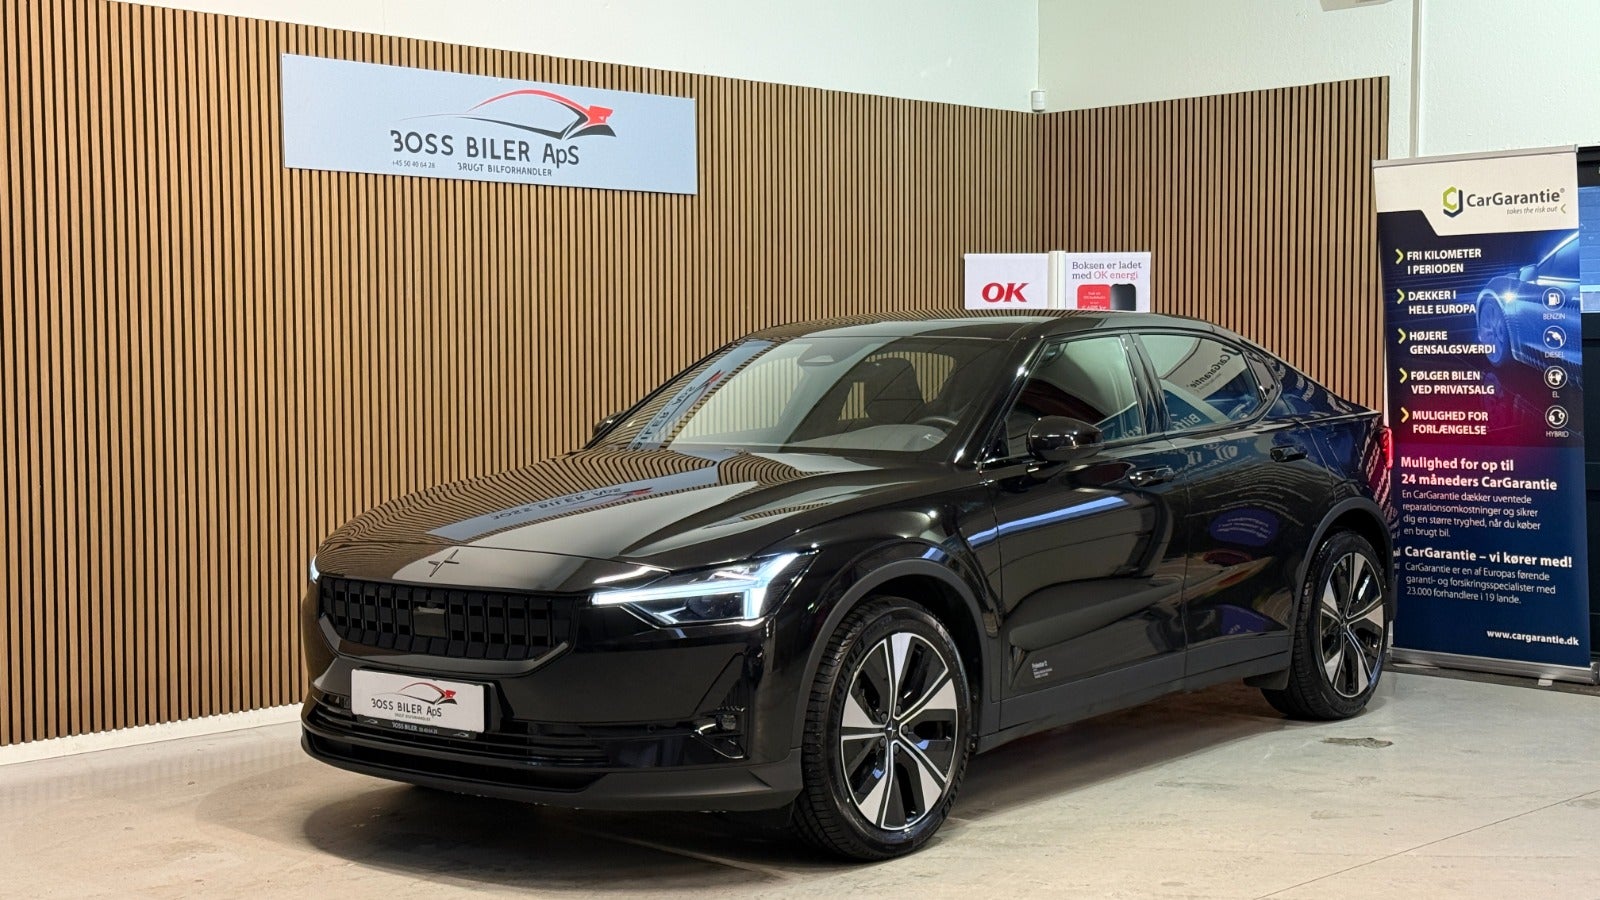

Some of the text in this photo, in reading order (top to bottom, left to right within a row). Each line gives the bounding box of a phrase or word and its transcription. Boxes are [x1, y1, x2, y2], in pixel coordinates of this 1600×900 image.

[466, 136, 531, 162] BILER
[542, 143, 580, 169] ApS
[487, 165, 552, 177] BILFORHANDLER
[1506, 207, 1523, 215] takes
[1534, 206, 1545, 214] risk
[1407, 248, 1482, 261] FRI KILOMETER
[1072, 261, 1105, 270] Boksen
[1118, 260, 1142, 269] ladet
[1412, 263, 1464, 274] PERIODEN
[1072, 270, 1139, 280] med OK energi
[981, 282, 1029, 303] OK
[1408, 291, 1451, 301] DÆKKER
[1408, 304, 1476, 315] HELE EUROPA
[1409, 330, 1448, 341] HØJERE
[1409, 344, 1496, 355] GENSALGSVÆRDI
[1544, 351, 1565, 359] DIESEL
[1411, 370, 1481, 381] FØLGER BILEN
[1411, 384, 1495, 395] VED PRIVATSALG
[1412, 410, 1489, 422] MULIGHED FOR
[1413, 424, 1487, 435] FORLÆNGELSE
[1545, 430, 1569, 438] HYBRID
[1400, 456, 1514, 473] Mulighed for op til
[1401, 473, 1558, 491] 24 måneders CarGarantie
[1402, 490, 1532, 504] En CarGarantie dækker uventede
[1402, 502, 1538, 518] reparationsomkostninger og sikrer
[1403, 515, 1541, 530] dig en større tryghed, når du køber
[1415, 527, 1437, 538] brugt
[1439, 528, 1451, 537] bil.
[1404, 546, 1477, 561] CarGarantie
[1489, 552, 1500, 562] vi
[1503, 552, 1537, 566] kører
[1540, 556, 1573, 568] med!
[1405, 562, 1451, 574] CarGarantie
[1473, 566, 1482, 576] af
[1483, 568, 1516, 579] Europas
[1517, 570, 1550, 581] førende
[1405, 576, 1556, 594] garanti- og forsikringsspecialister med
[1406, 587, 1432, 597] 23.000
[1433, 588, 1479, 600] forhandlere
[1484, 593, 1495, 601] 19
[1496, 593, 1522, 604] lande.
[1486, 630, 1580, 646] www.cargarantie.dk
[397, 702, 422, 714] BILER
[426, 705, 442, 718] ApS
